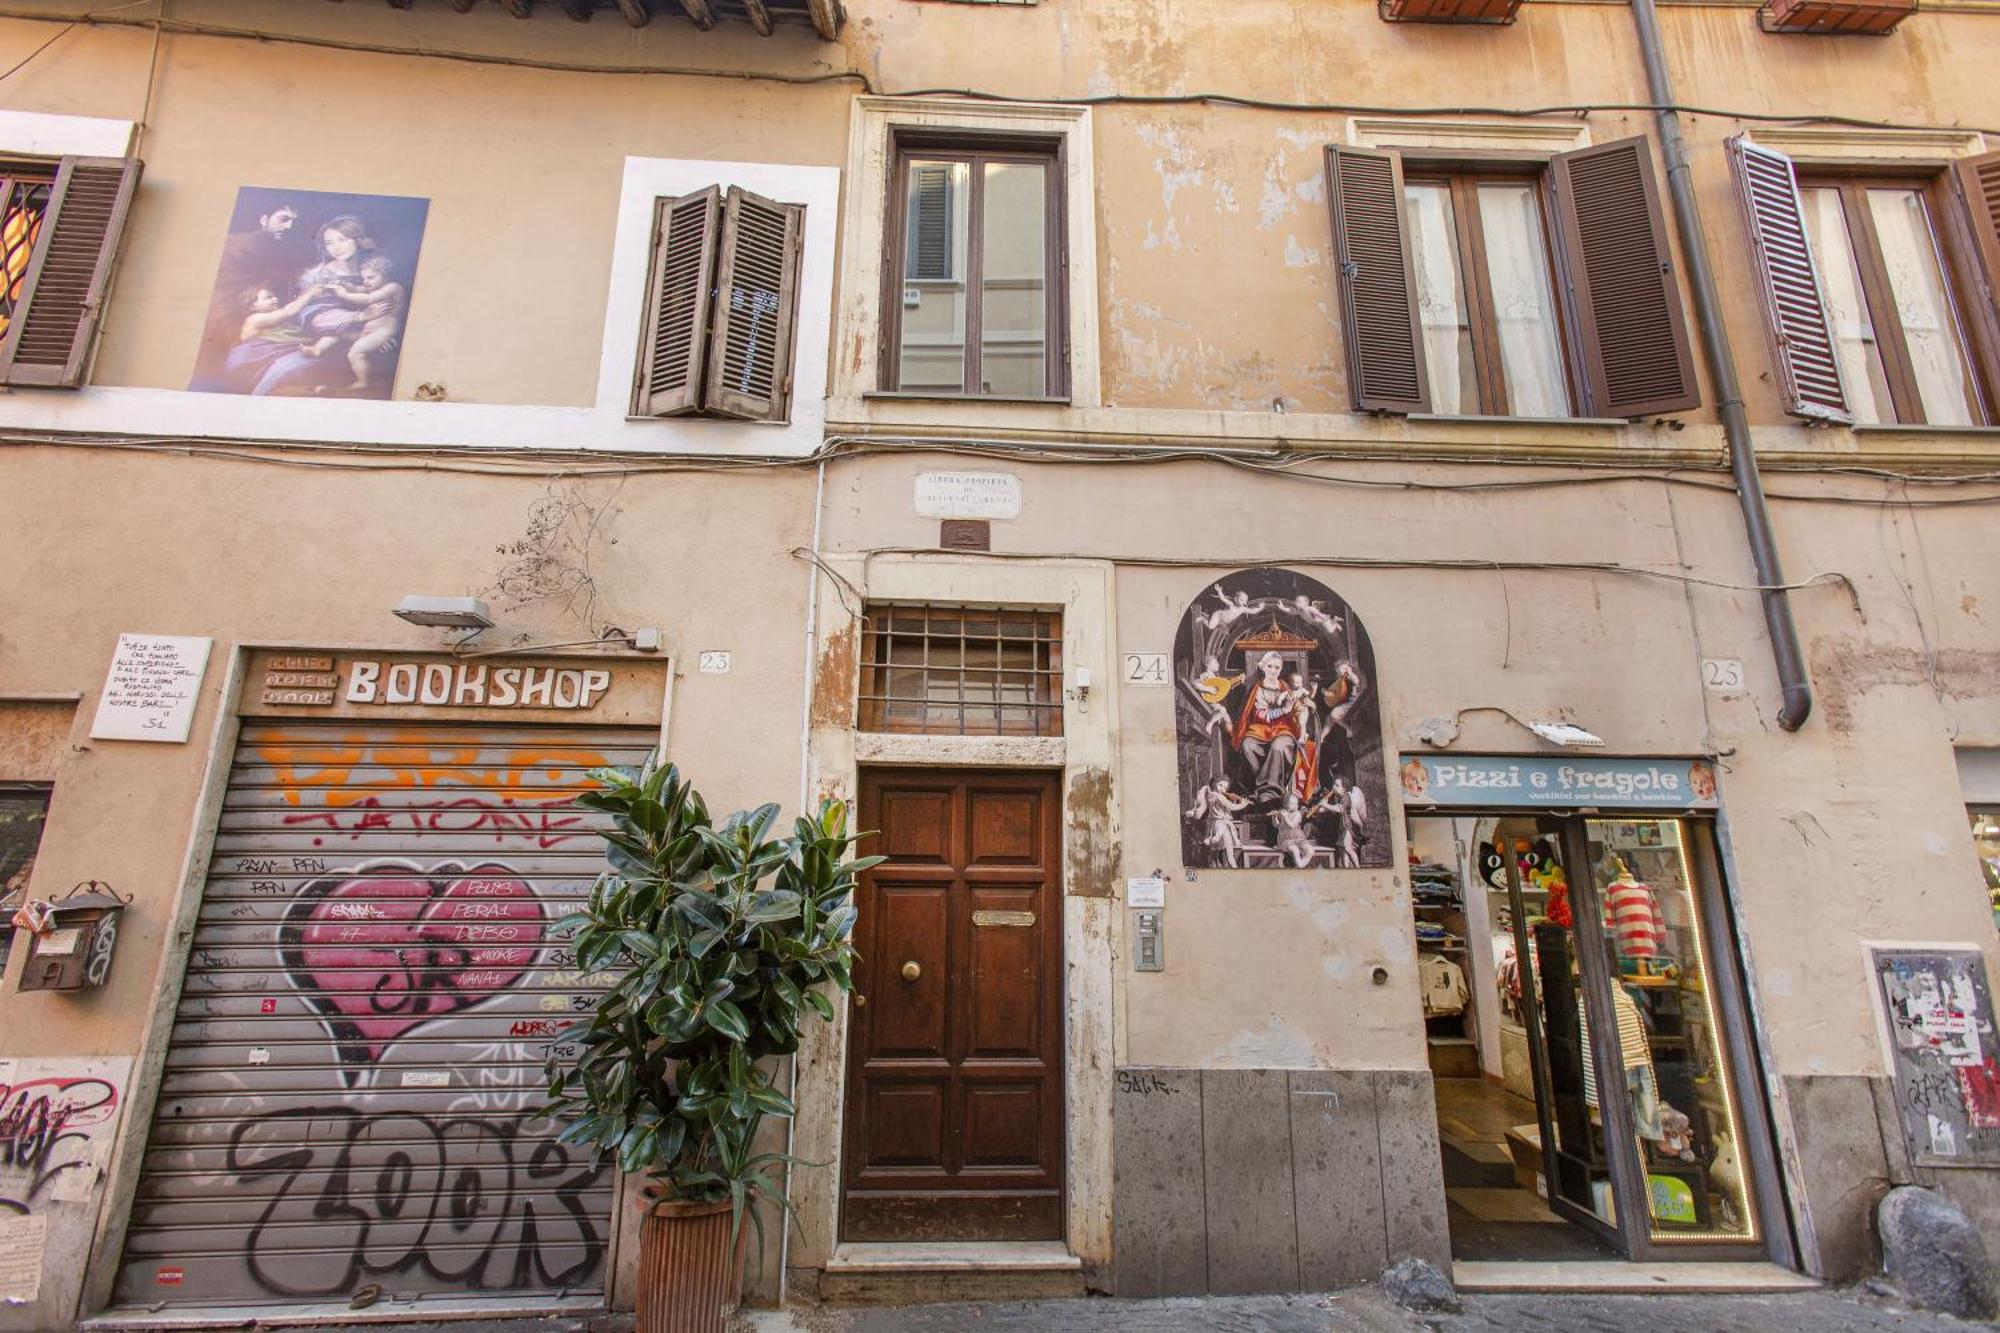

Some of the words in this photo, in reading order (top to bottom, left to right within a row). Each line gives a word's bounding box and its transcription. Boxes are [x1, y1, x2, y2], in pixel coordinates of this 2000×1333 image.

[703, 654, 727, 670] 23
[1127, 655, 1165, 681] 24
[1705, 662, 1738, 686] 25
[346, 661, 610, 708] BOOKSHOP
[1433, 765, 1522, 789] Pizzi
[1530, 771, 1548, 788] e
[1558, 766, 1679, 794] fragole
